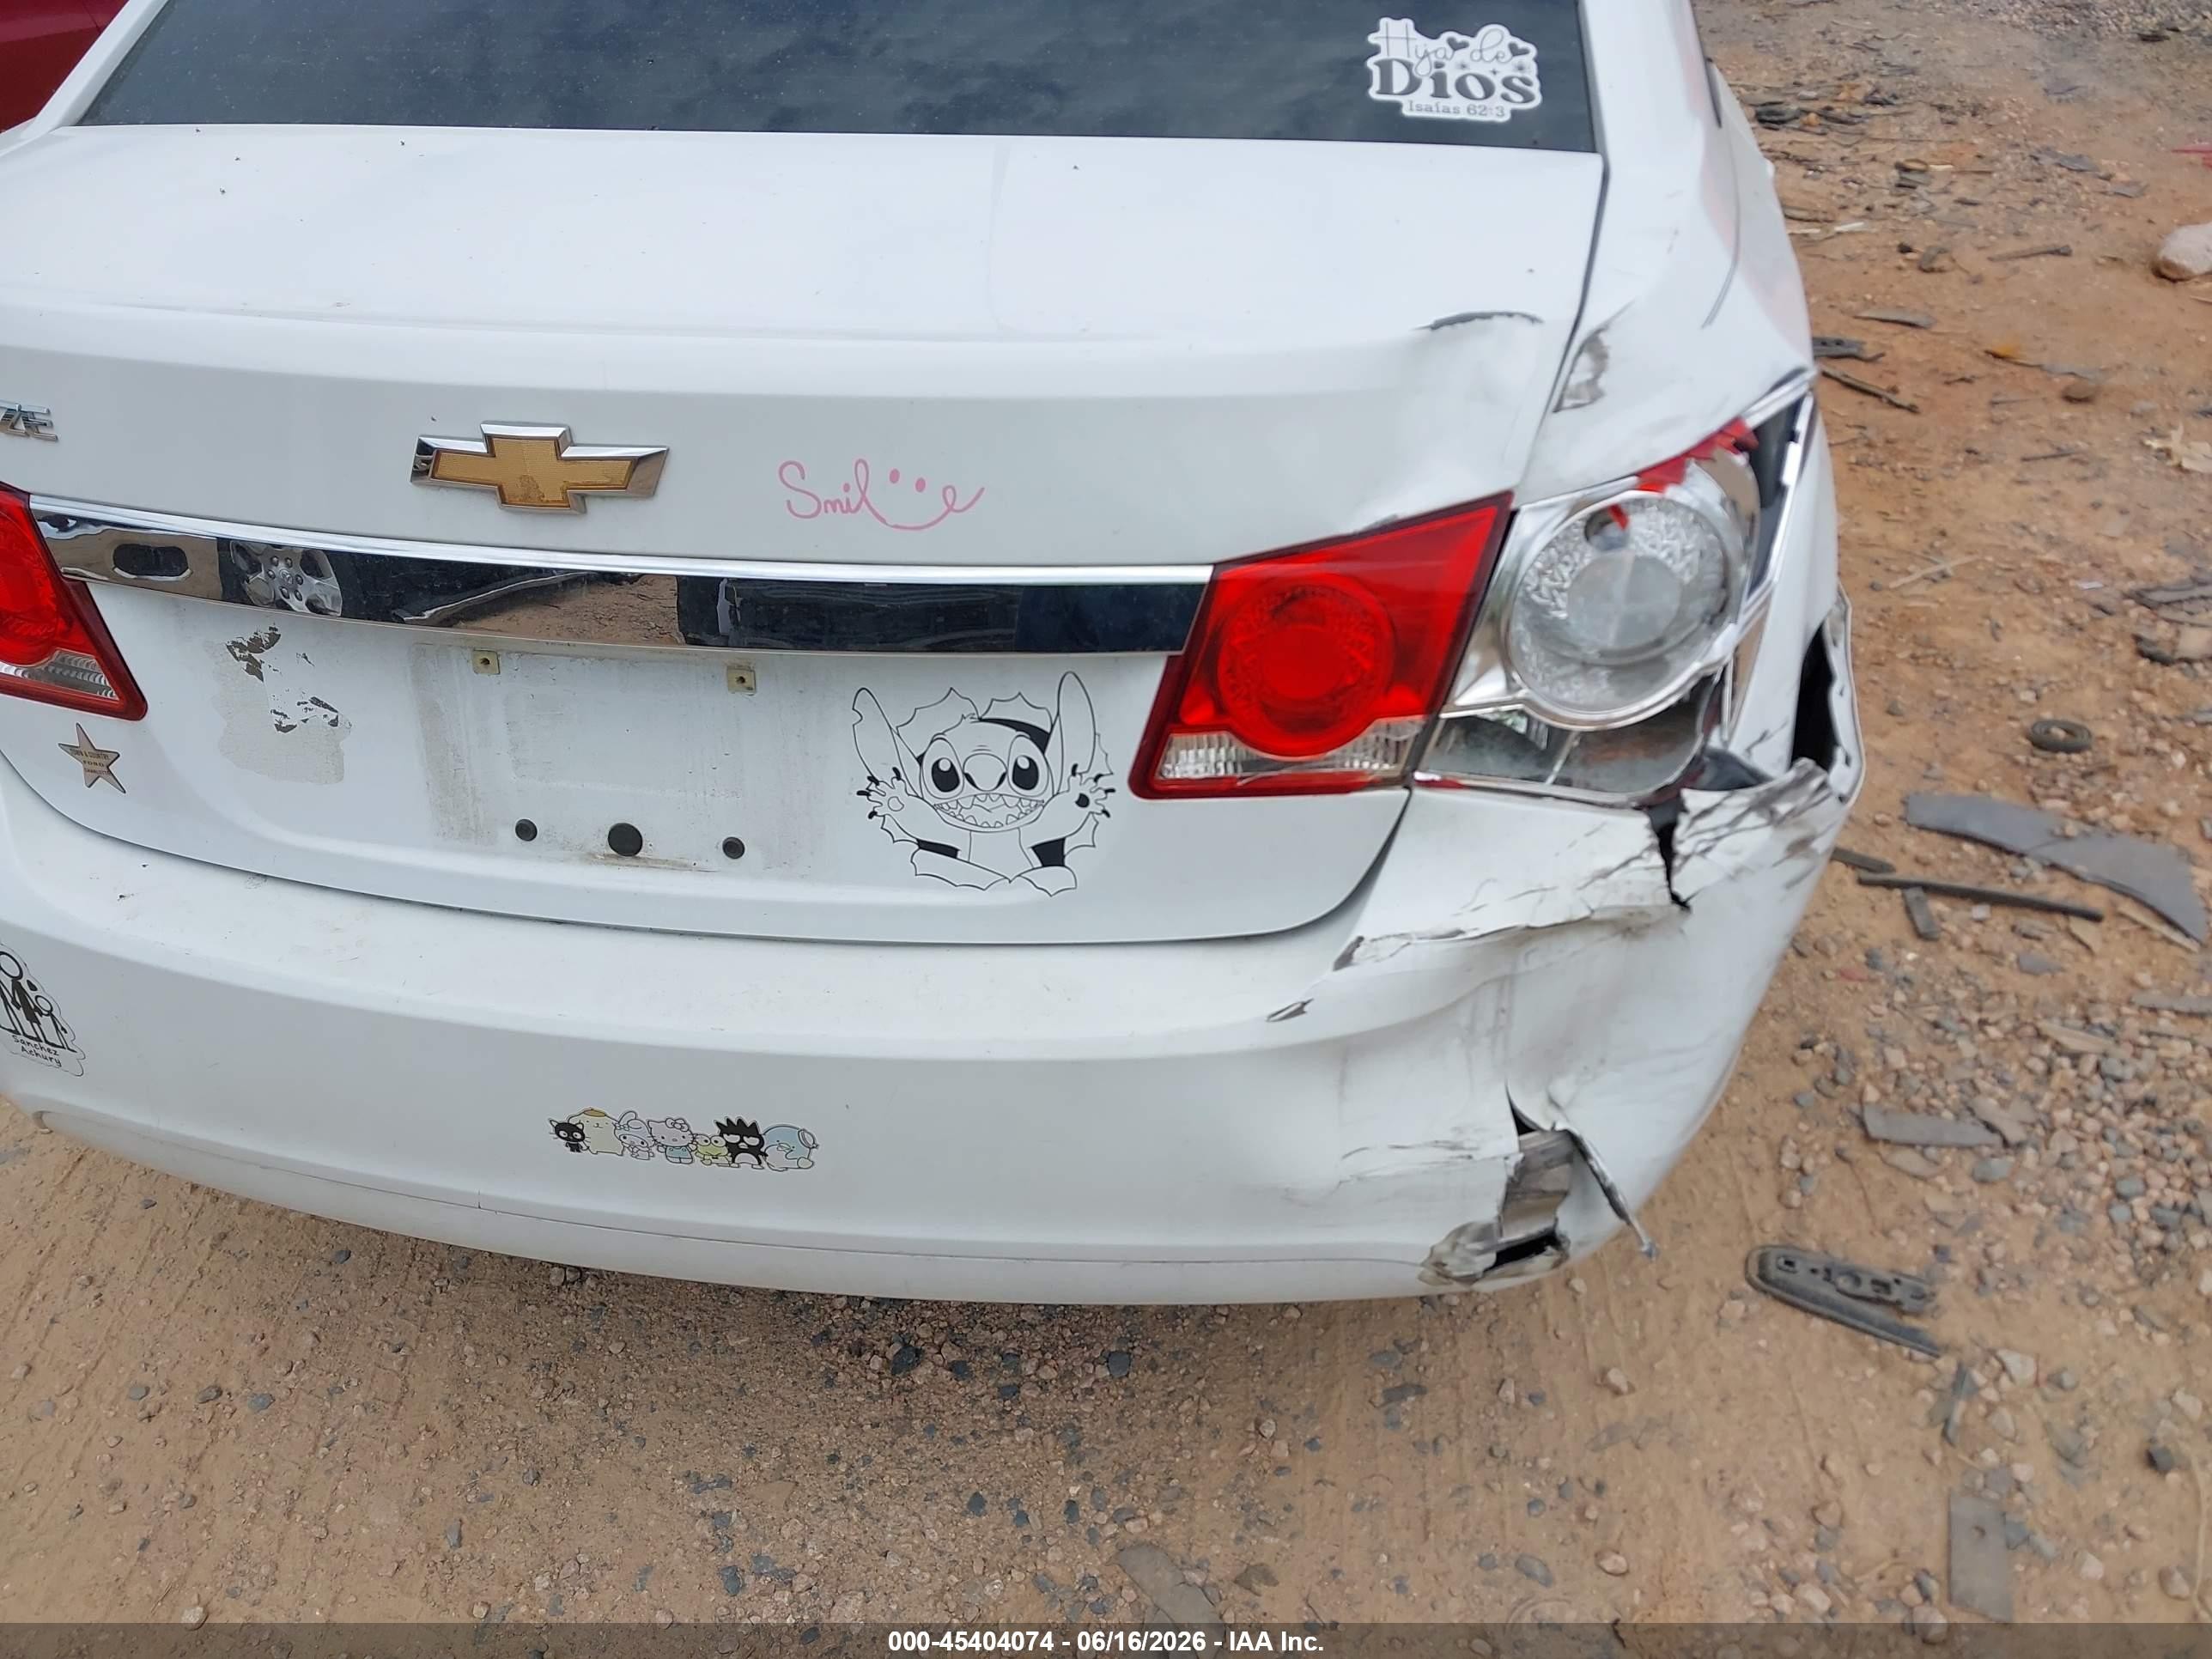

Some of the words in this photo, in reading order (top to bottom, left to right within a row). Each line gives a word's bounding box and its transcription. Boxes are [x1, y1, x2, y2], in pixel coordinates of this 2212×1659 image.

[1373, 21, 1454, 76] Hija
[1470, 27, 1510, 64] de
[1374, 58, 1535, 104] Dios
[1467, 104, 1505, 118] 62:3
[778, 458, 985, 531] Smile
[12, 1035, 59, 1056] Sanchez
[21, 1046, 62, 1067] Achury
